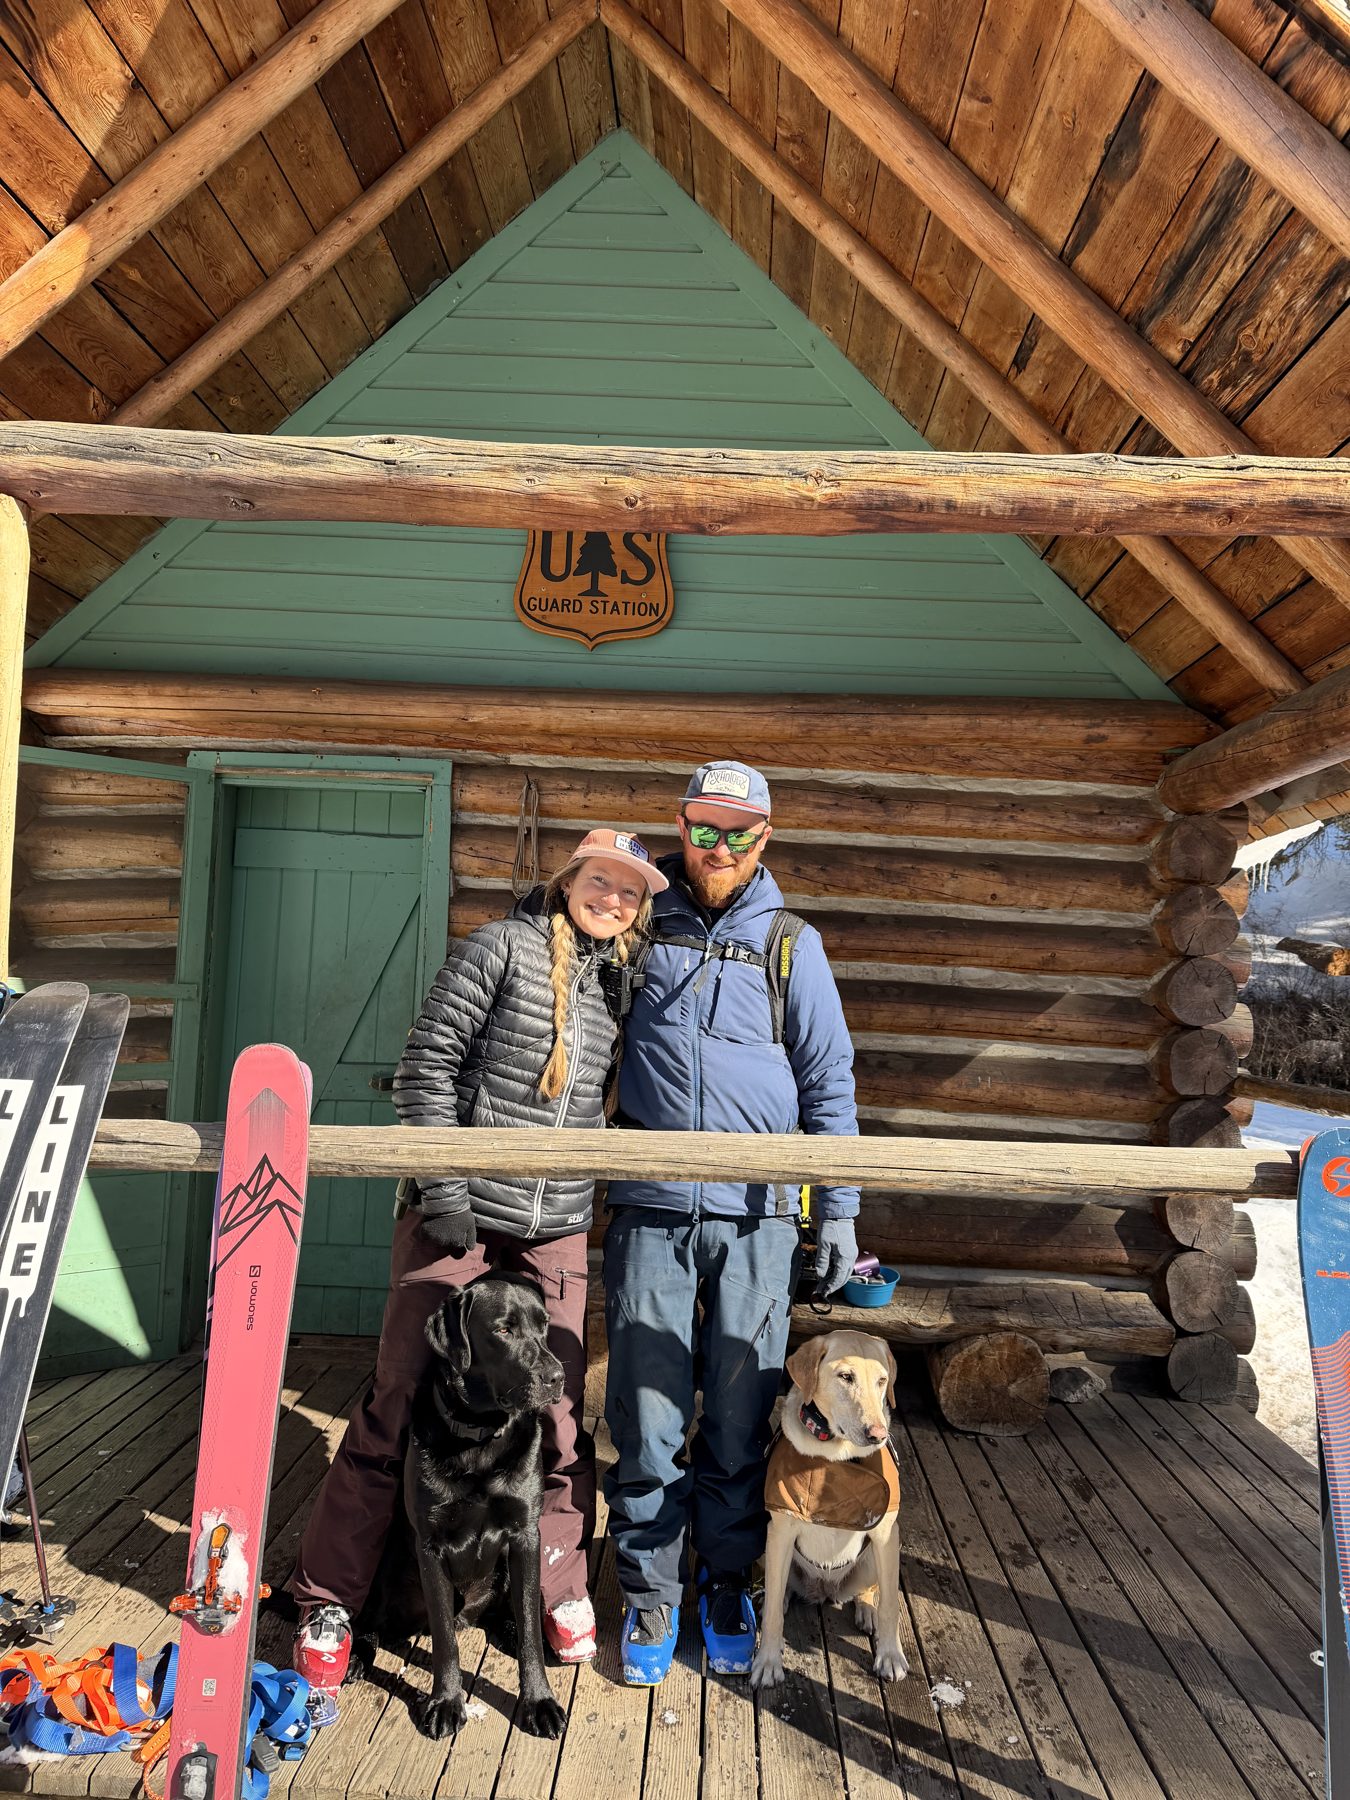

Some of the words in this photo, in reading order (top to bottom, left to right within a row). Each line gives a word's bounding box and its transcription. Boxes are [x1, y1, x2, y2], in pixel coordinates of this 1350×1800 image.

[527, 597, 582, 613] GUARD
[589, 600, 660, 617] STATION
[10, 1095, 69, 1277] LINE
[247, 1280, 258, 1330] salomon
